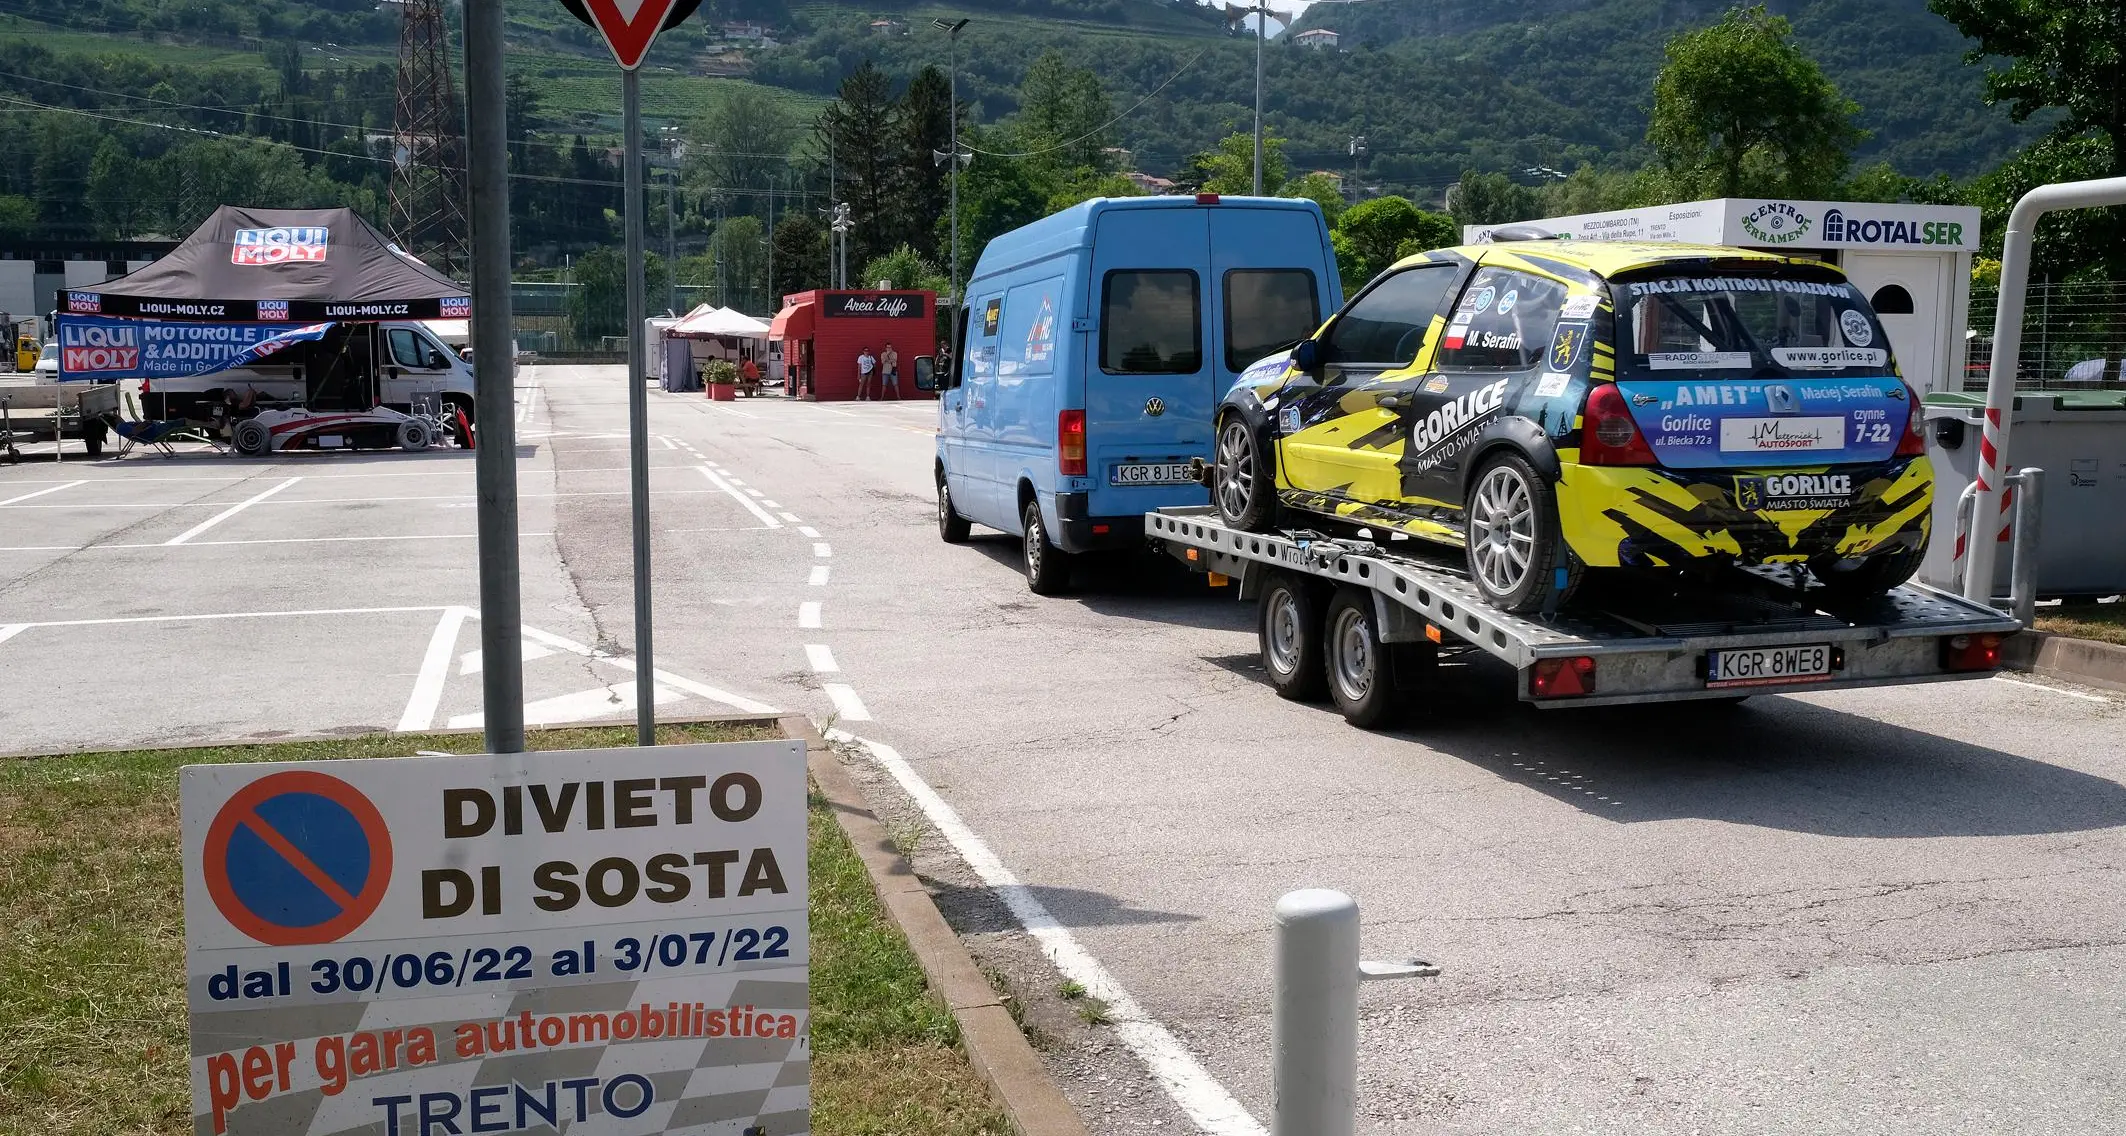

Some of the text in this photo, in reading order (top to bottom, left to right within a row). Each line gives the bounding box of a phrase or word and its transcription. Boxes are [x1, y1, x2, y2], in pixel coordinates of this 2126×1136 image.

[1750, 203, 1804, 225] CENTRO
[1584, 219, 1627, 230] MEZZOLOMBARDO
[1741, 215, 1812, 244] SERRAMENTI
[1846, 219, 1963, 246] ROTALSER
[238, 228, 326, 247] LIQUI
[237, 244, 325, 263] MOLY
[69, 293, 99, 303] LIQUI
[1629, 280, 1692, 296] STACJA
[1771, 279, 1851, 299] POJAZDÓW
[69, 302, 100, 312] MOLY
[140, 303, 225, 315] LIQUI-MOLY.CZ
[257, 301, 288, 311] LIQUI
[326, 305, 408, 316] LIQUI-MOLY.CZ
[441, 298, 470, 308] LIQUI
[441, 307, 471, 317] MOLY
[844, 298, 908, 317] Area Zuffo
[257, 310, 288, 320] MOLY
[65, 326, 134, 349] LIQUI
[1467, 330, 1522, 350] M. Serafin
[67, 349, 138, 370] MOLY
[143, 361, 177, 371] Made
[181, 361, 192, 371] in
[1786, 350, 1877, 364] www.gorlice.pl
[1801, 385, 1883, 402] Maciej Serafin
[1413, 378, 1509, 451] GORLICE
[1662, 414, 1711, 431] Gorlice
[1854, 409, 1886, 420] czynne
[1655, 436, 1666, 445] ul.
[1668, 435, 1693, 445] Biecka
[1695, 436, 1706, 444] 72
[1855, 423, 1891, 443] 7-22
[1759, 440, 1813, 448] AUTOSPORT
[1418, 442, 1455, 474] MIASTO
[1120, 466, 1149, 481] KGR
[1766, 475, 1850, 495] GORLICE
[1766, 500, 1807, 510] MIASTO
[1723, 648, 1824, 677] KGR 8WE8
[443, 771, 763, 840] DIVIETO
[421, 848, 788, 920] DI SOSTA
[207, 926, 790, 1001] dal 30/06/22 al 3/07/22
[206, 1002, 798, 1136] per gara automobilistica
[372, 1073, 654, 1136] TRENTO
